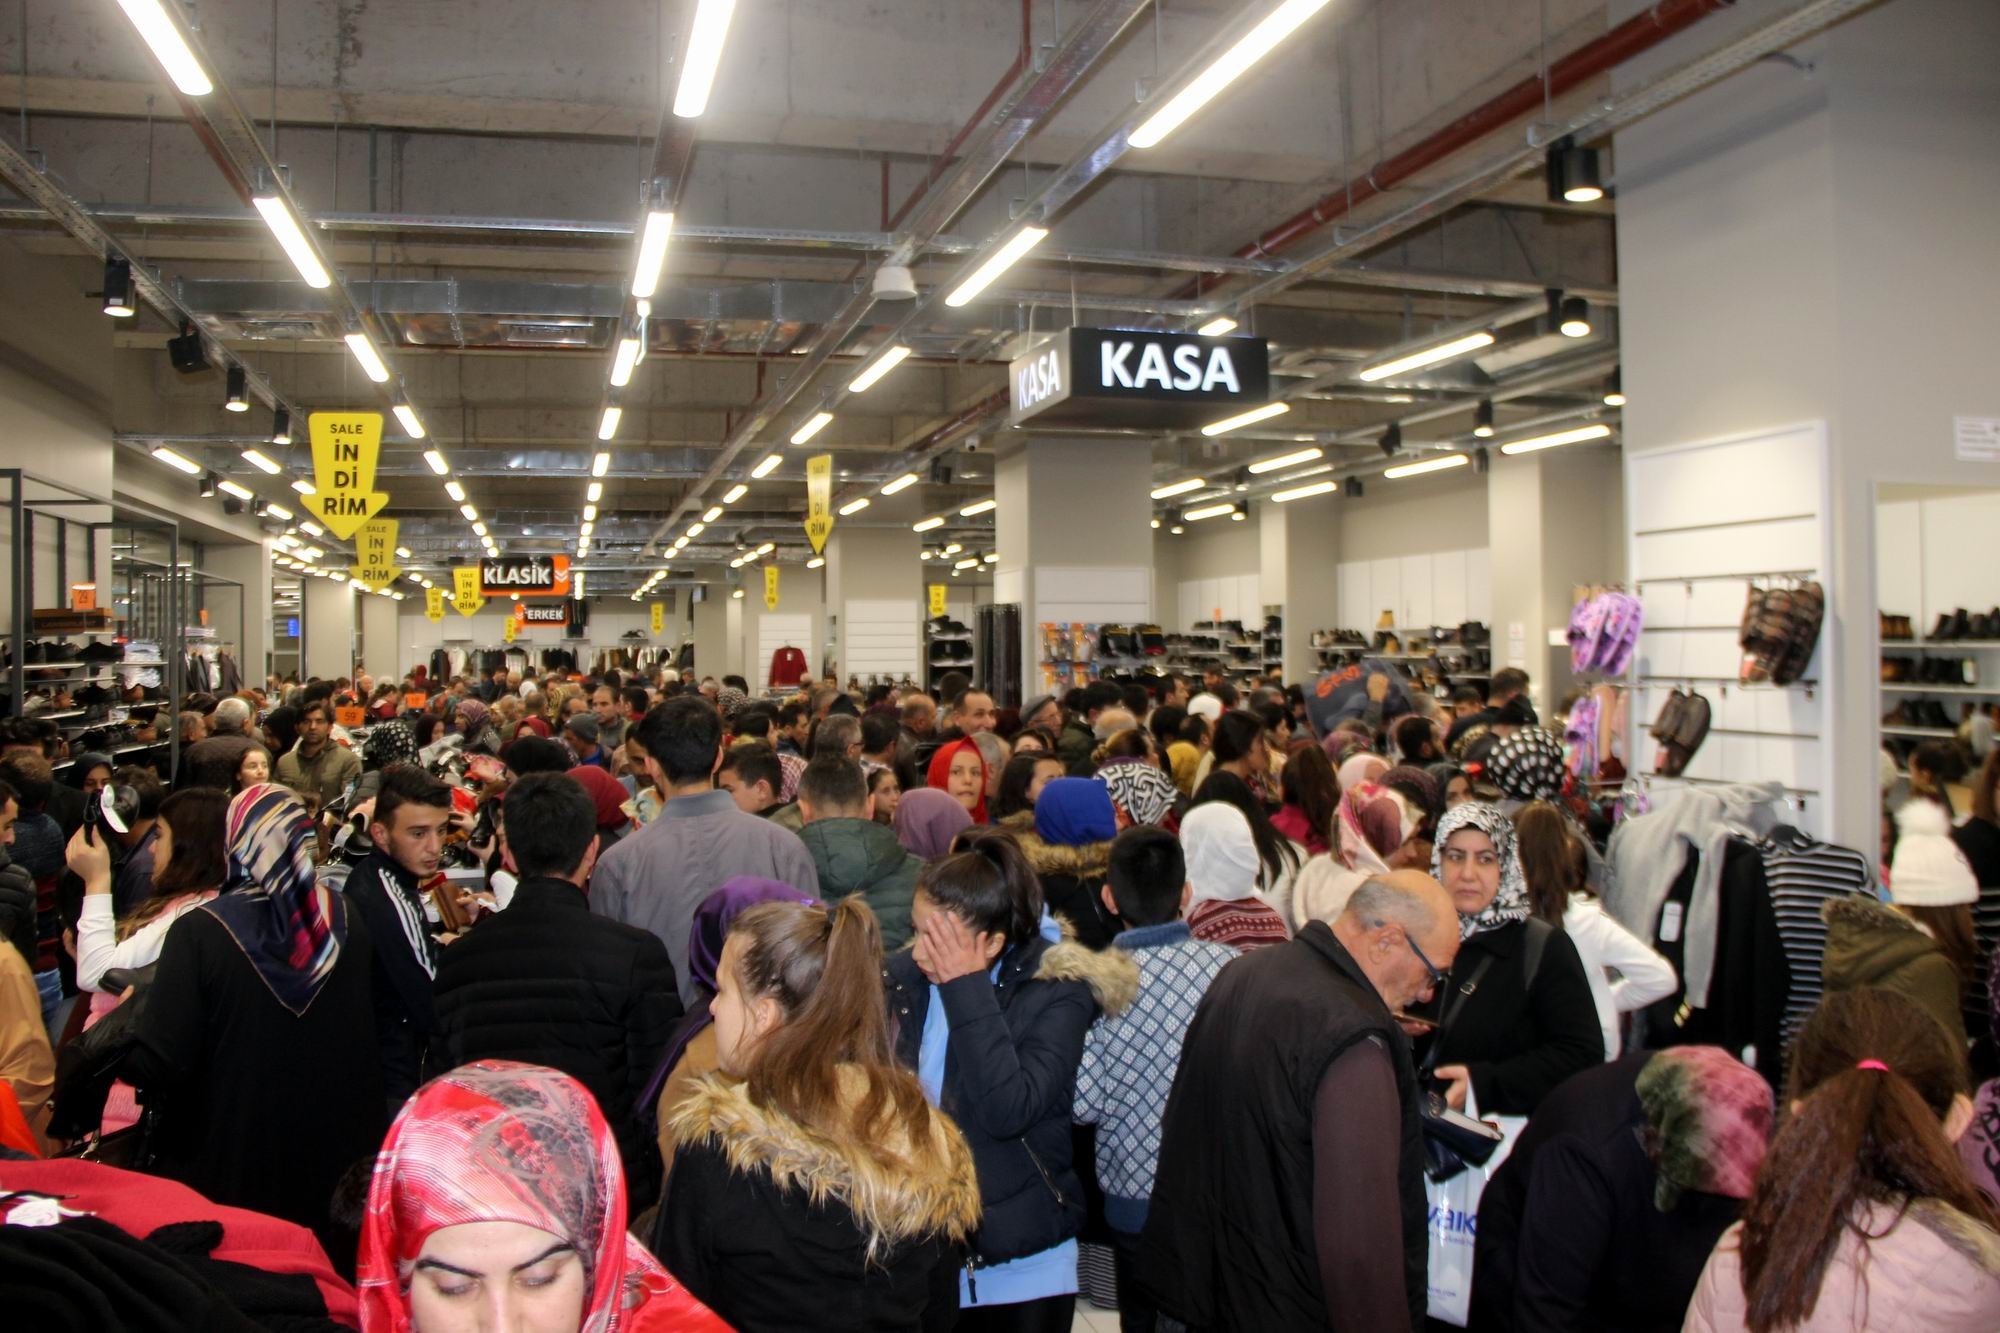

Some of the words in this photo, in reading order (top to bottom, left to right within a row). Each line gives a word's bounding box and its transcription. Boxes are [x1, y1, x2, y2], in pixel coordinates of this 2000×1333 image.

[1101, 340, 1240, 393] KASA
[1018, 350, 1060, 411] KASA
[330, 424, 363, 434] SALE
[334, 439, 359, 461] İN
[334, 466, 357, 488] Dİ
[323, 493, 367, 516] RİM
[366, 525, 387, 533] SALE
[369, 535, 384, 549] İN
[369, 551, 383, 565] Dİ
[363, 567, 389, 581] RİM
[483, 564, 551, 585] KLASİK
[527, 609, 564, 620] ERKEK
[344, 711, 357, 722] 59
